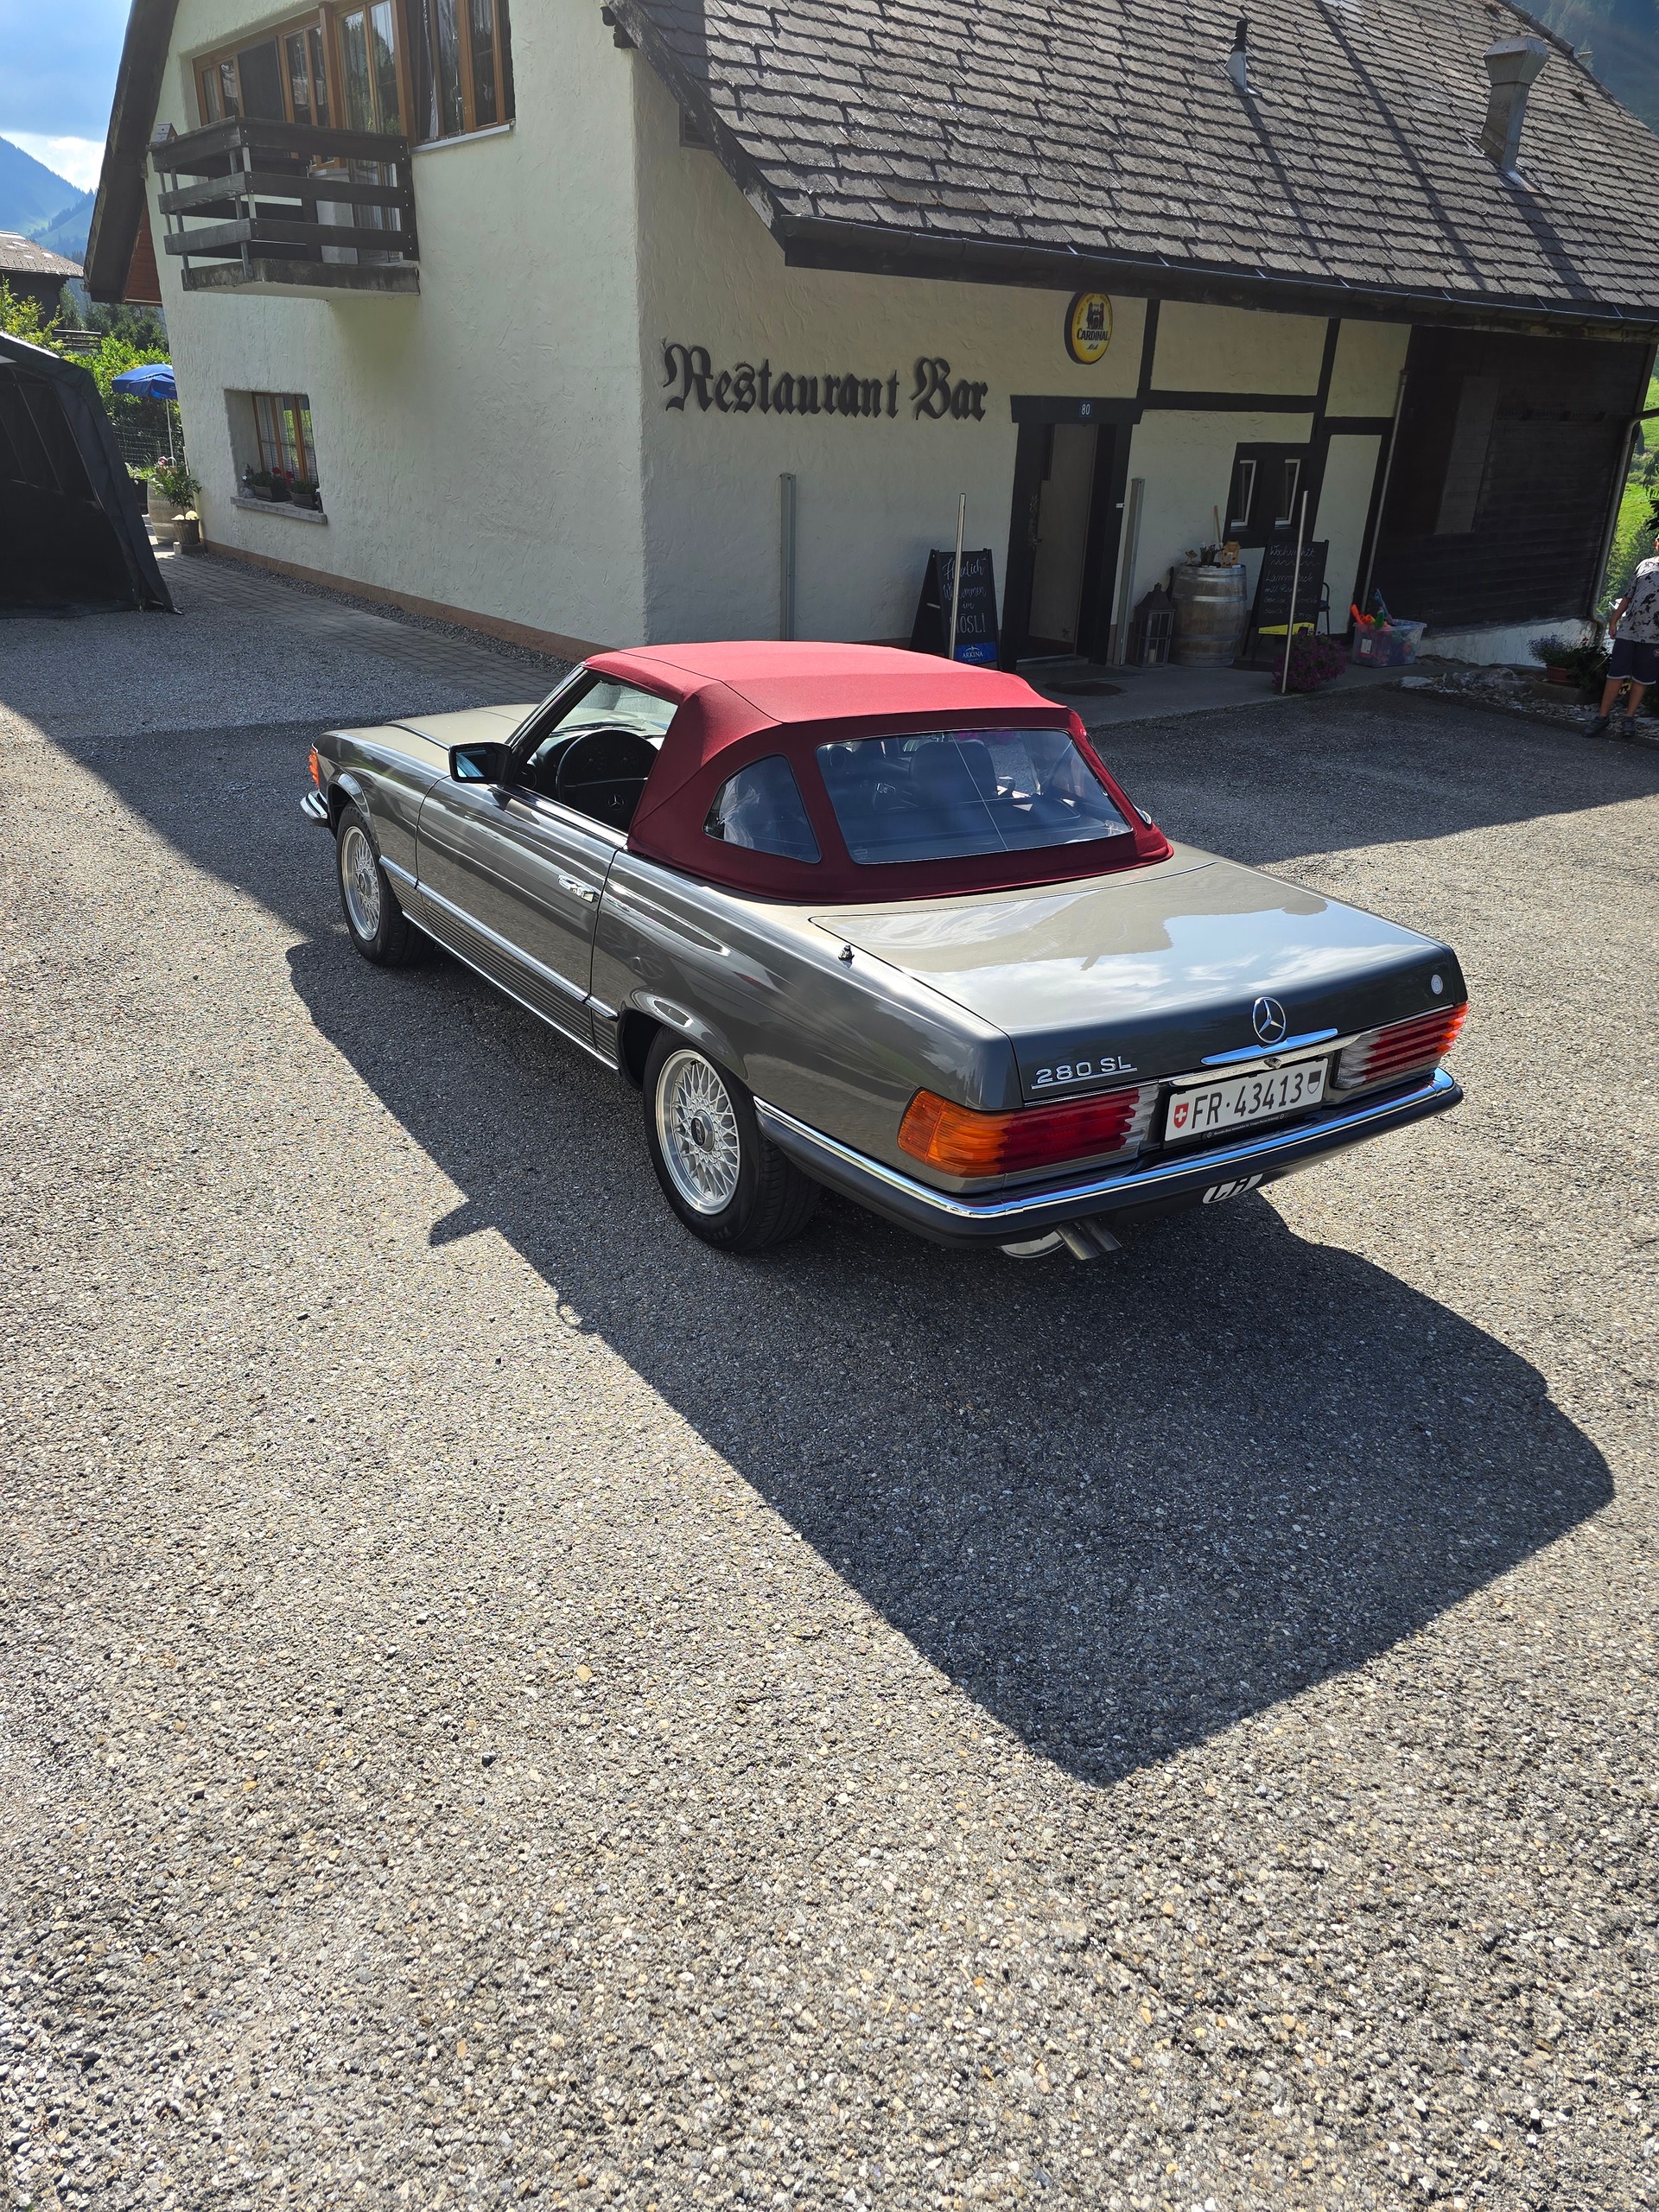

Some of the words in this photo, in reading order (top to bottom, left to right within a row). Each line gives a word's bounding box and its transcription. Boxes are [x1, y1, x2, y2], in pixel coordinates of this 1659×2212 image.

[1077, 327, 1109, 340] CARDINAL
[663, 343, 899, 418] Restaurant
[910, 356, 988, 422] Bar
[1081, 404, 1090, 415] 80
[1035, 1061, 1092, 1084] 280
[1099, 1055, 1132, 1072] SL
